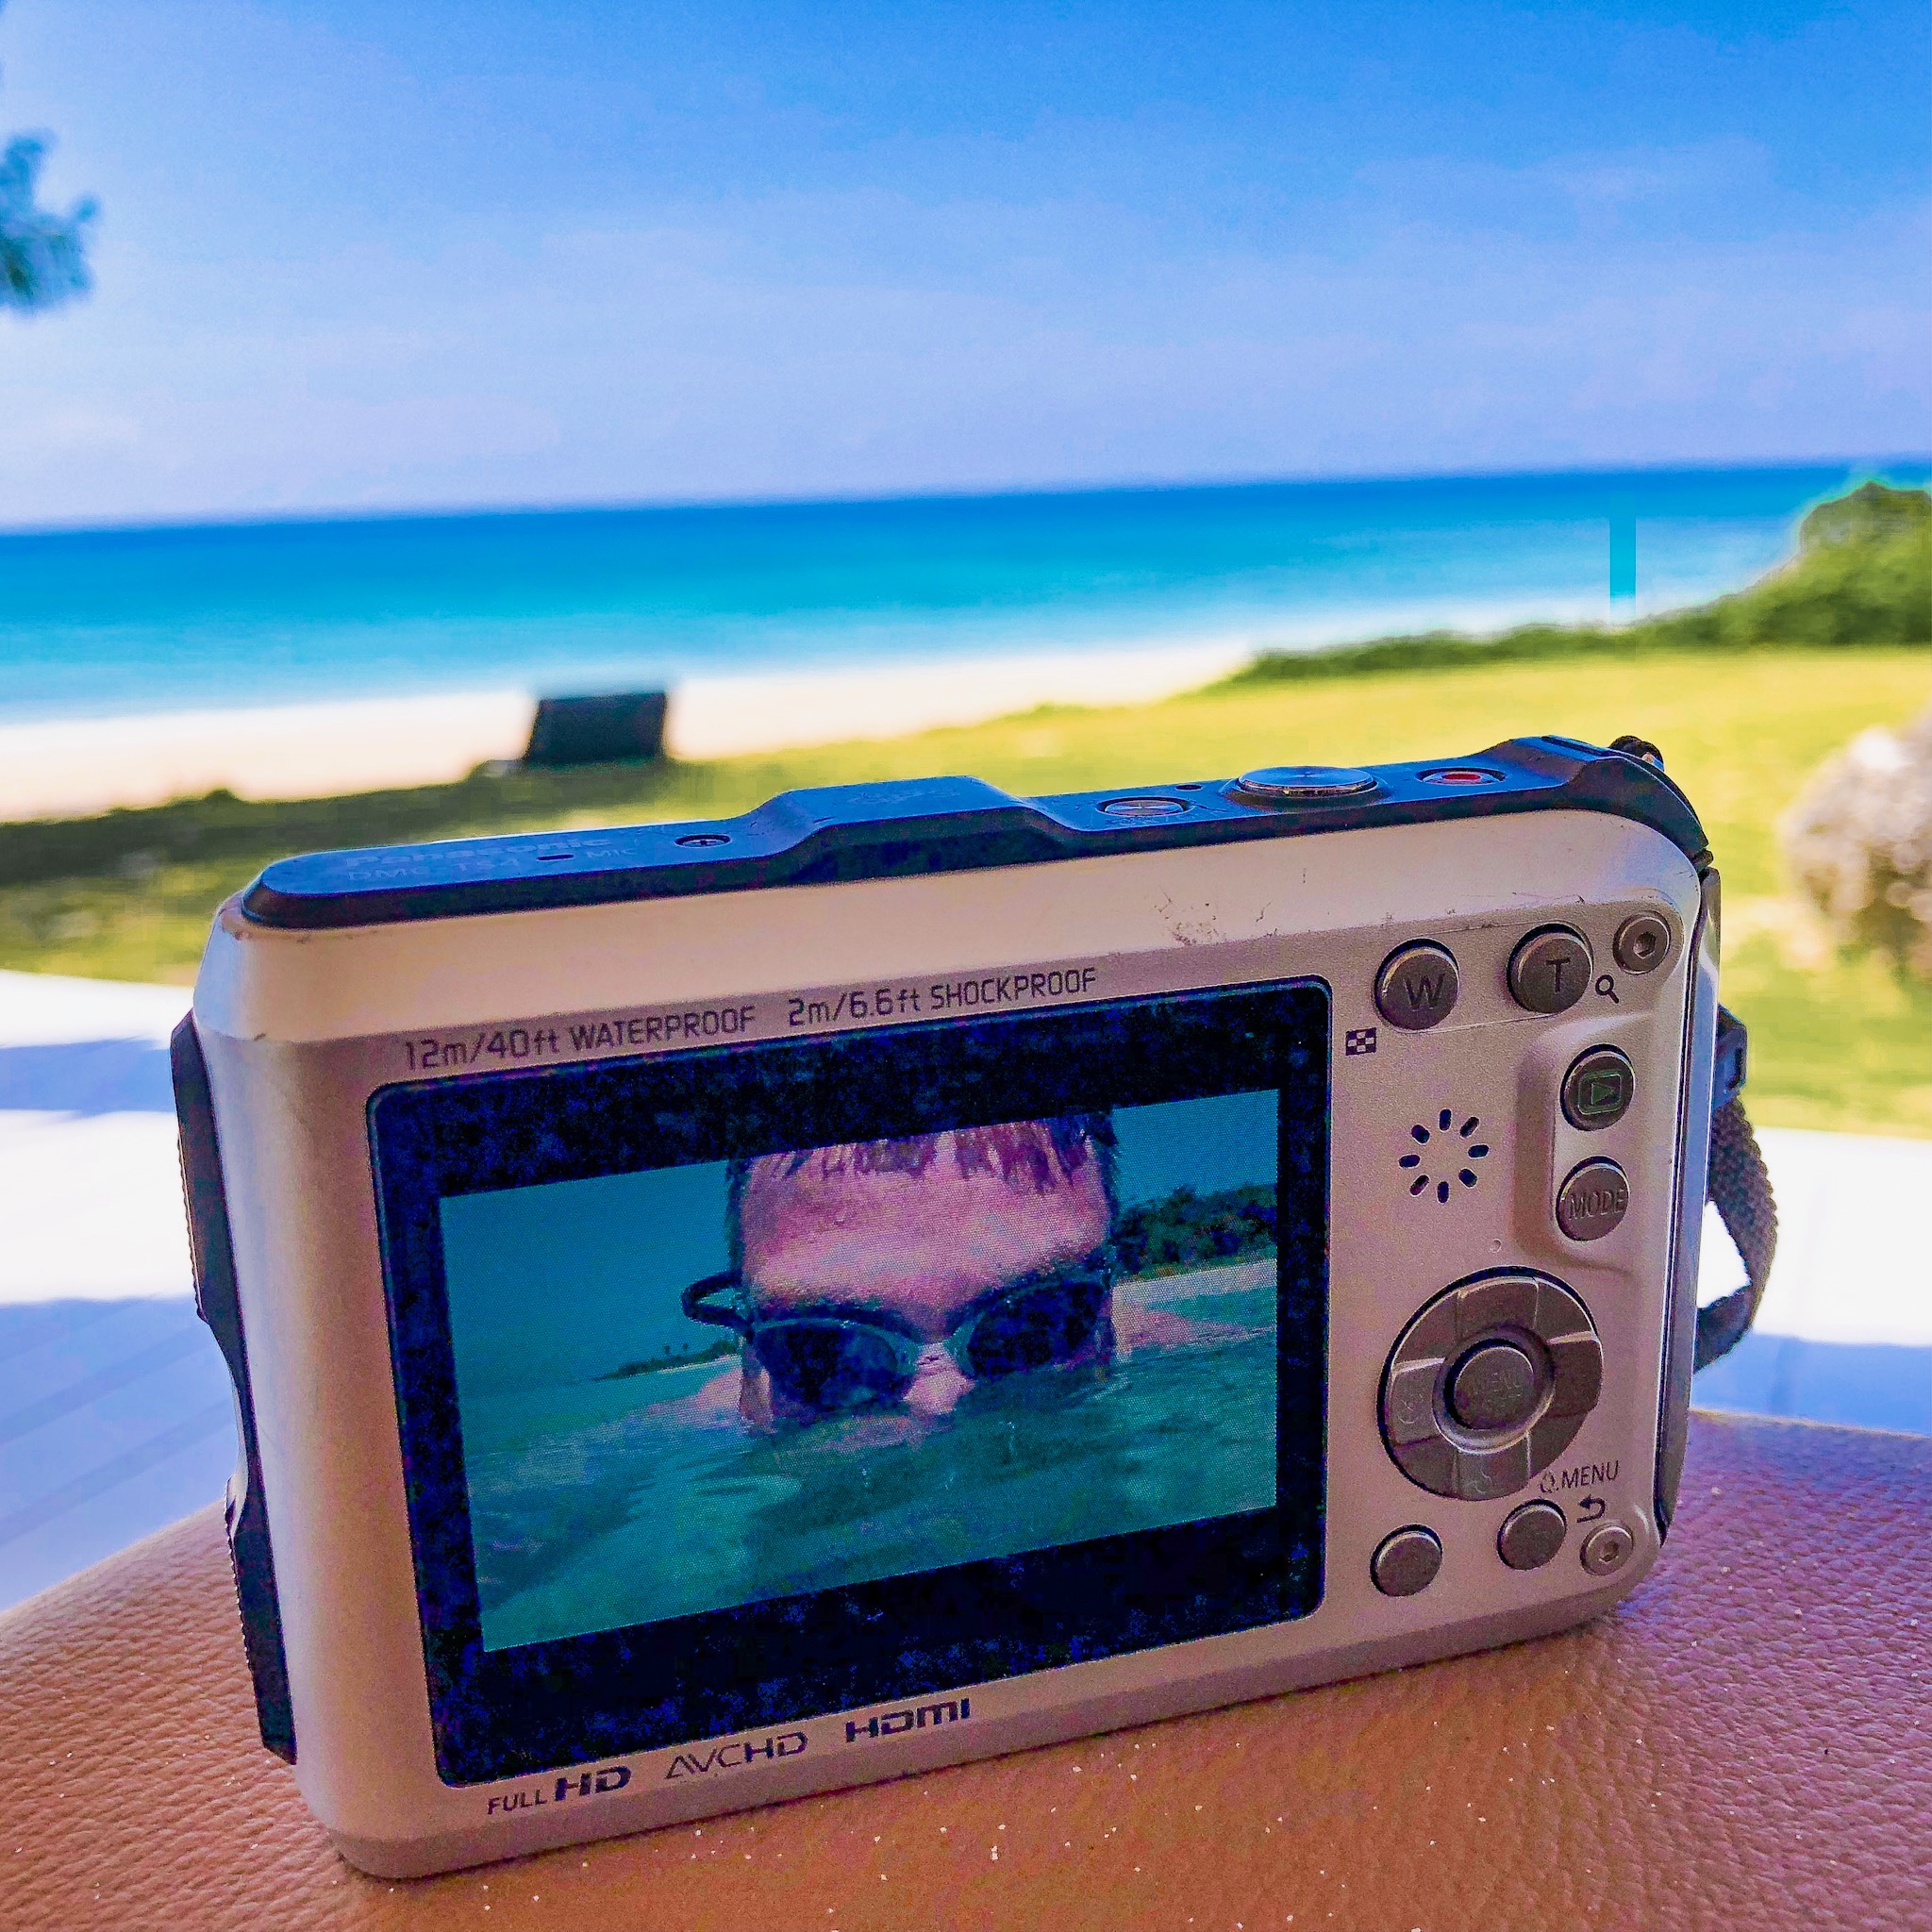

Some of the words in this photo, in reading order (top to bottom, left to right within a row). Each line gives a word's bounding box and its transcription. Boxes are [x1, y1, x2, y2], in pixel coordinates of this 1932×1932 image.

[1403, 974, 1446, 1010] W
[1545, 958, 1570, 994] T
[404, 1028, 560, 1072] 12m/40ft
[569, 1008, 755, 1052] WATERPROOF
[788, 988, 921, 1027] 2m/6.6ft
[930, 967, 1096, 1010] SHOCKPROOF
[1568, 1188, 1626, 1221] MODE
[845, 1697, 971, 1743] HDMI
[664, 1731, 808, 1780] AVCHD
[487, 1789, 547, 1815] FULL
[554, 1765, 632, 1802] HD
